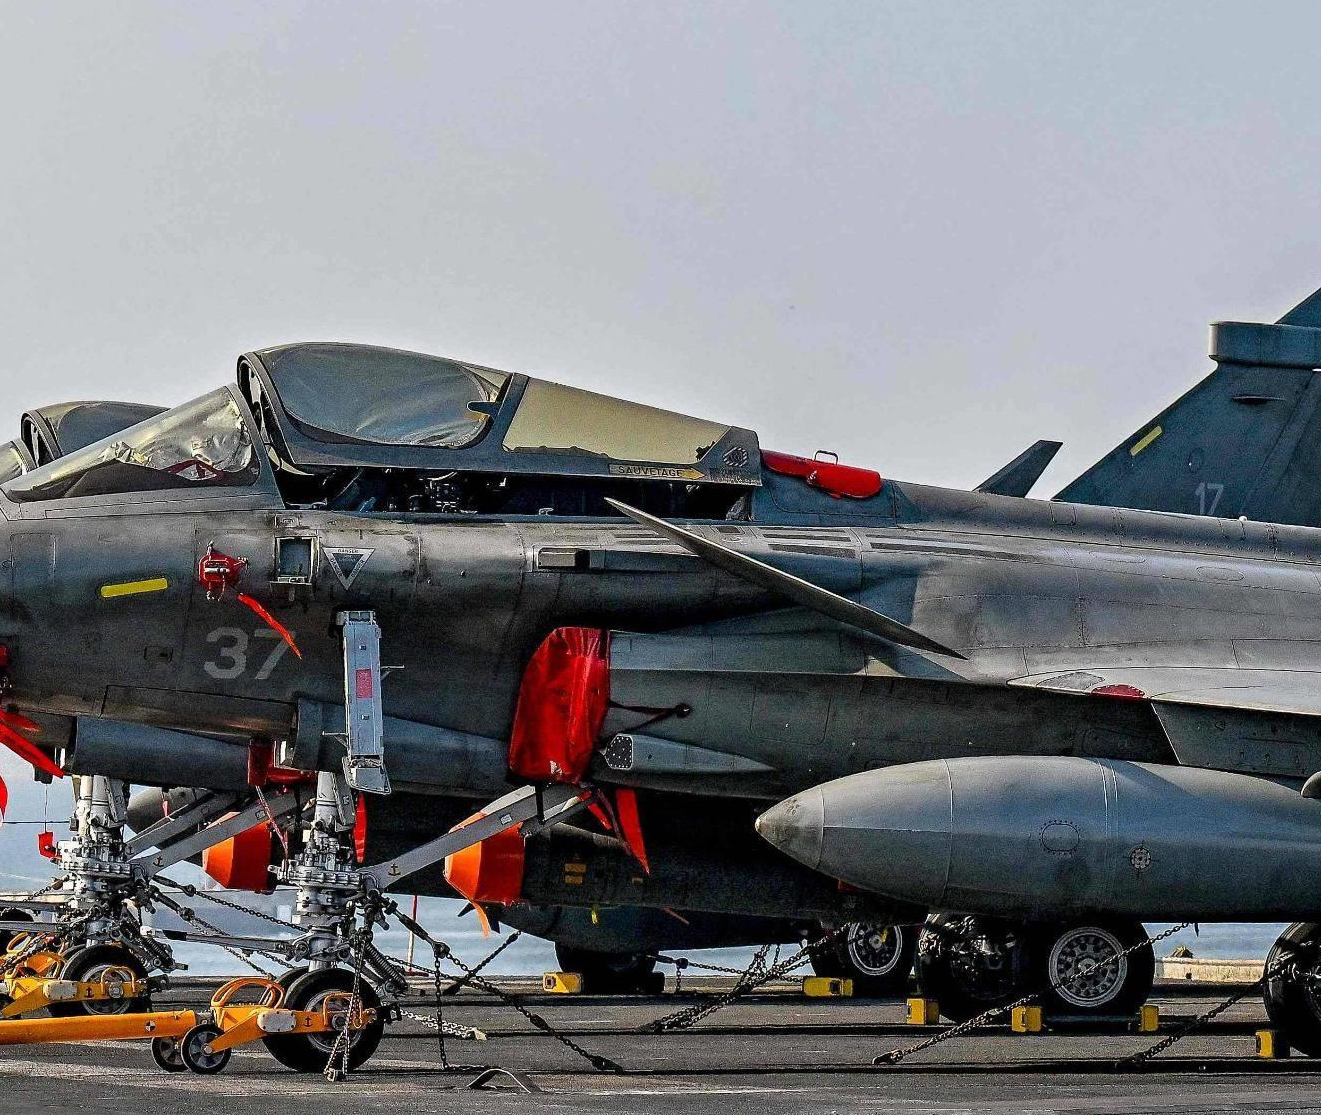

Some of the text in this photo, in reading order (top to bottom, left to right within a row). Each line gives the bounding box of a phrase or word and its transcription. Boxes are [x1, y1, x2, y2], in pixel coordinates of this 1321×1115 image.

[618, 465, 683, 478] SAUVETAGE
[1195, 481, 1224, 515] 17
[203, 626, 296, 680] 37
